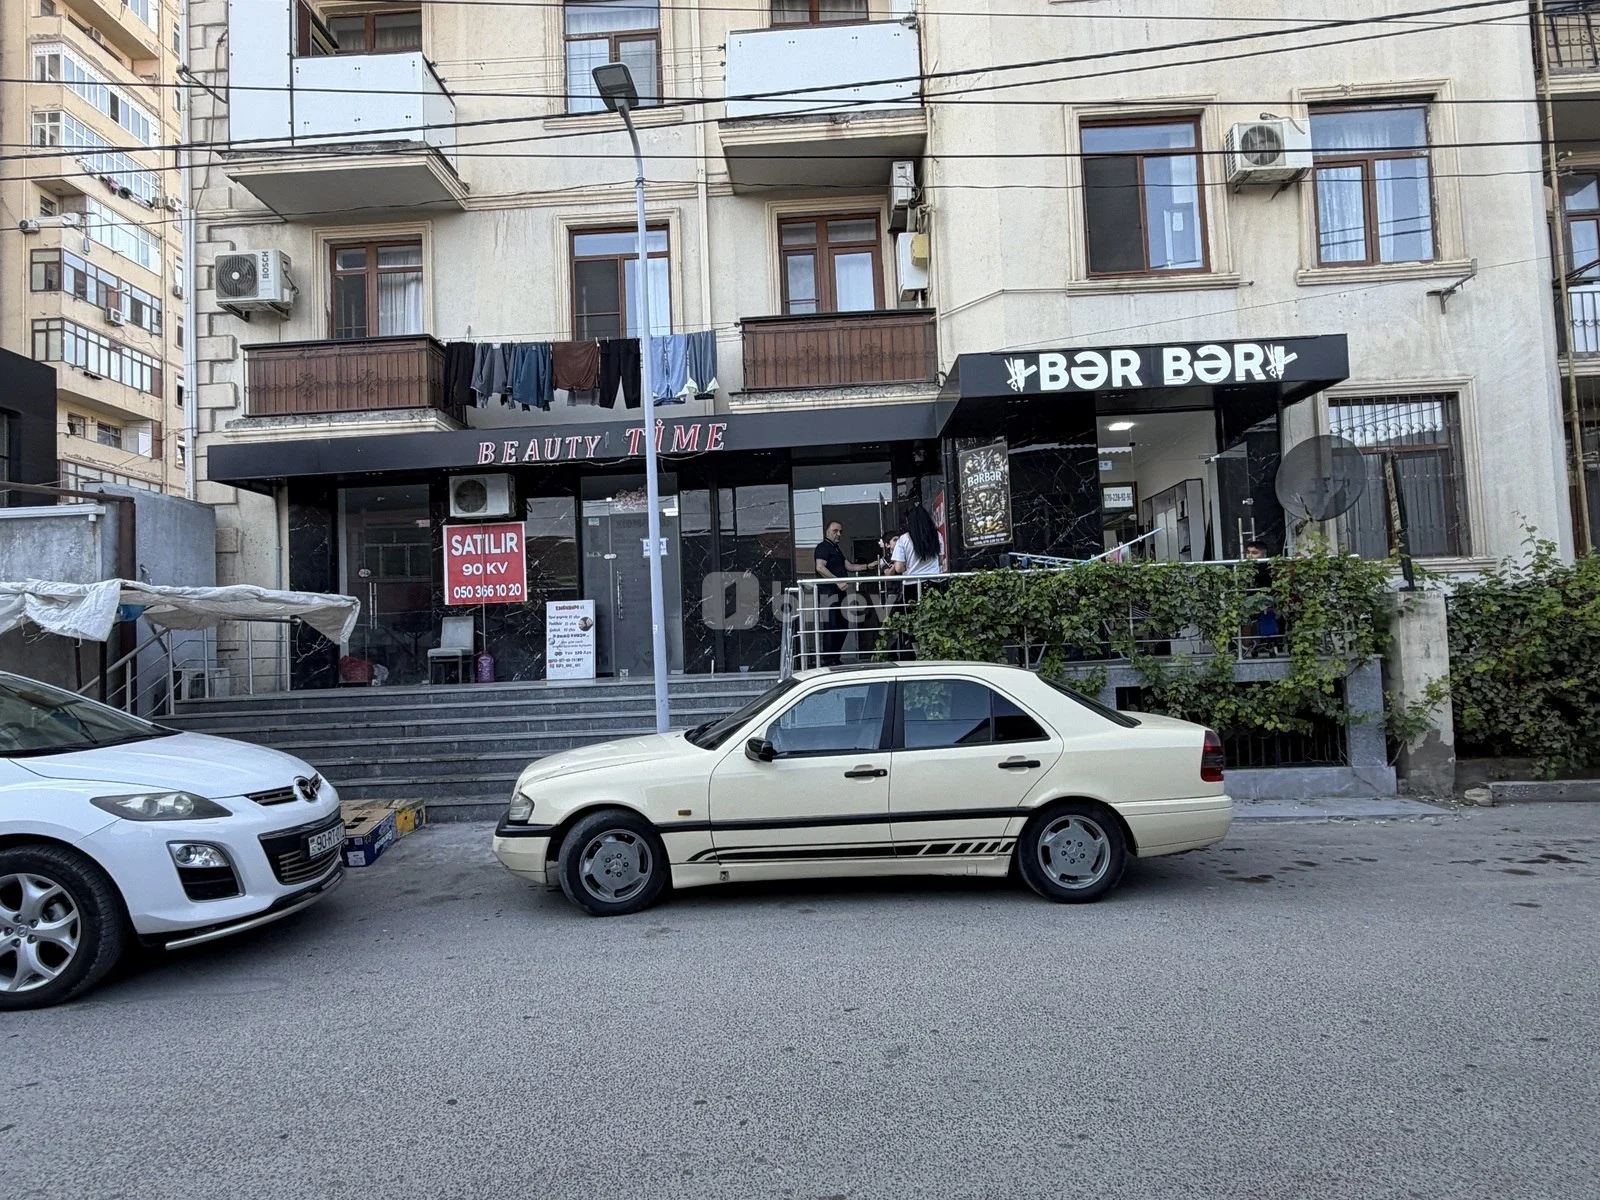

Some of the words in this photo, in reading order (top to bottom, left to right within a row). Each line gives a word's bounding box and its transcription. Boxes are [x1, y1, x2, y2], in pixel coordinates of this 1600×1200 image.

[261, 251, 269, 279] BOSCH
[1039, 349, 1143, 391] BƏR
[1163, 343, 1267, 386] BƏR
[477, 435, 602, 465] BEAUTY
[451, 532, 519, 556] SATILIR
[462, 563, 483, 576] 90
[486, 561, 509, 575] KV
[453, 585, 474, 599] 050
[475, 584, 494, 598] 366
[495, 583, 507, 597] 10
[508, 583, 522, 596] 20
